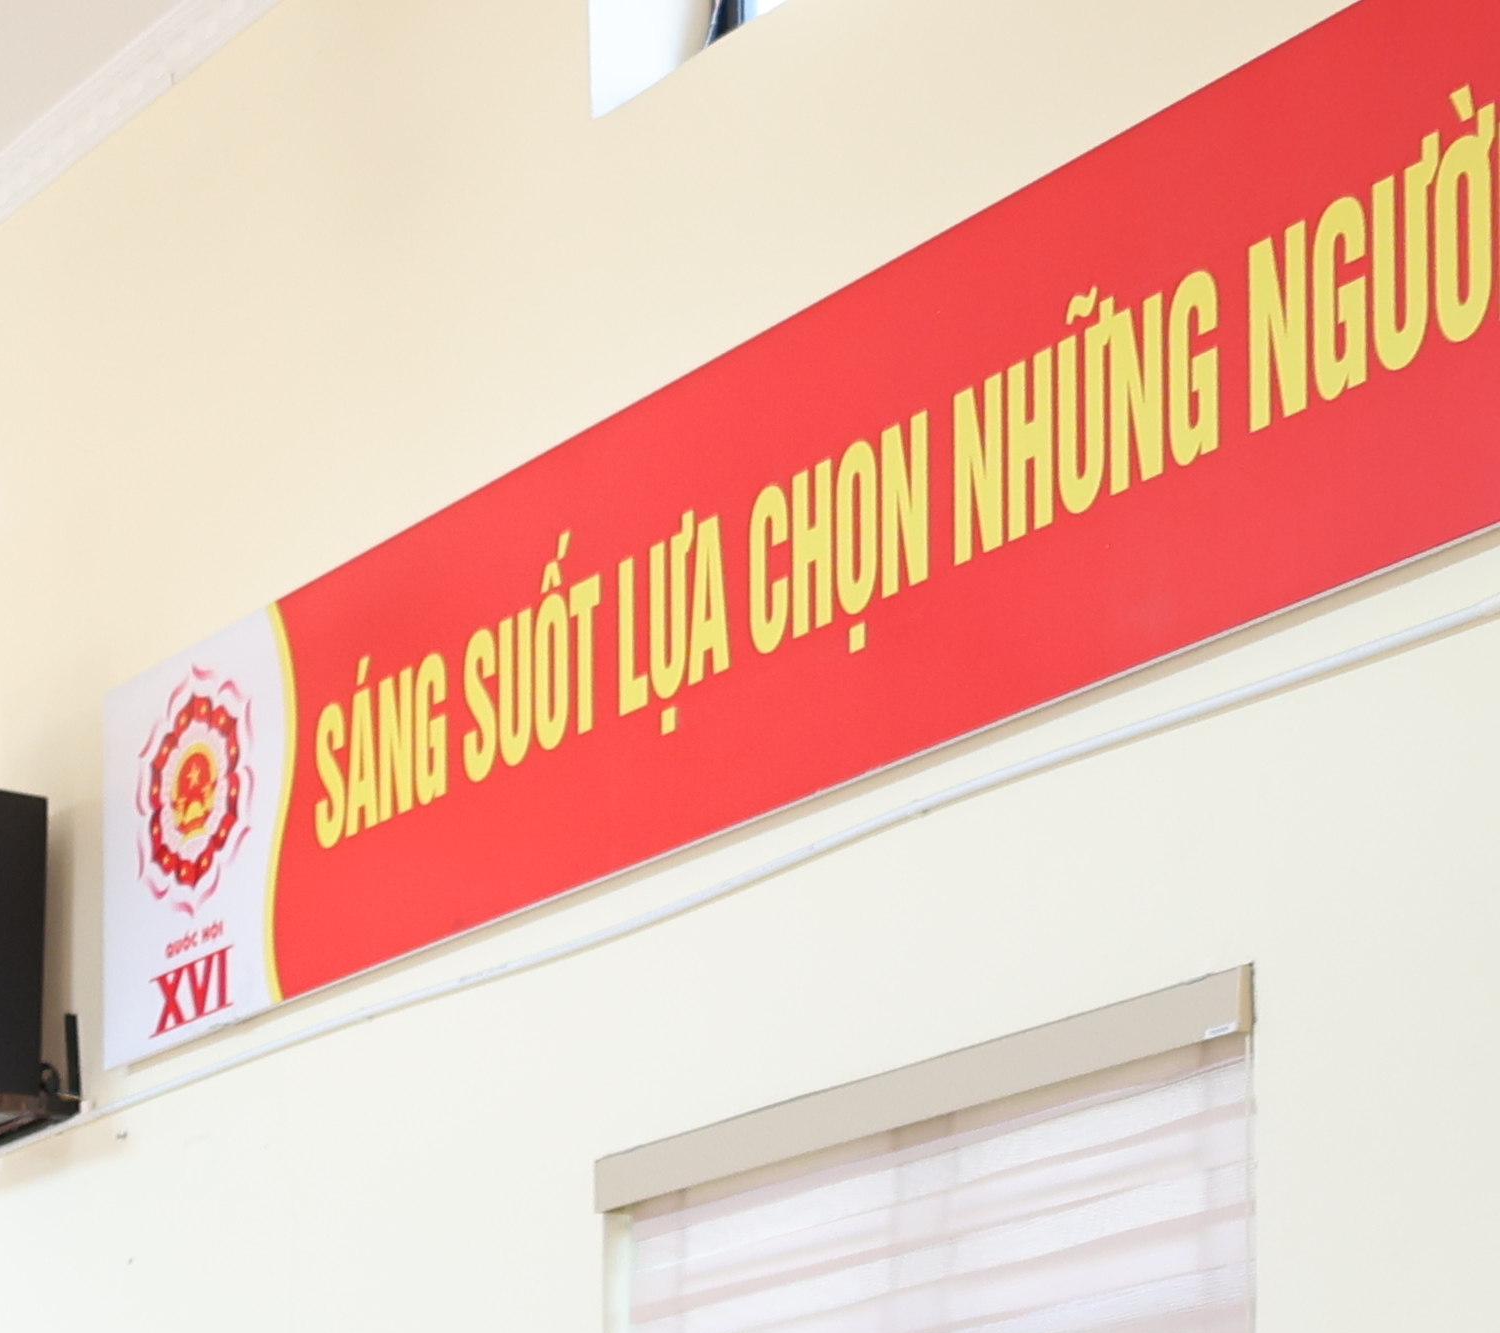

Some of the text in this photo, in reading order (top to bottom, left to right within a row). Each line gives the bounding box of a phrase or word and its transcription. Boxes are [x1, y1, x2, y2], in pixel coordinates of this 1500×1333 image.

[315, 83, 1500, 849] SÁNG SUỐT LỰA CHỌN NHỮNG NGƯỜ
[149, 944, 234, 1039] XVI
